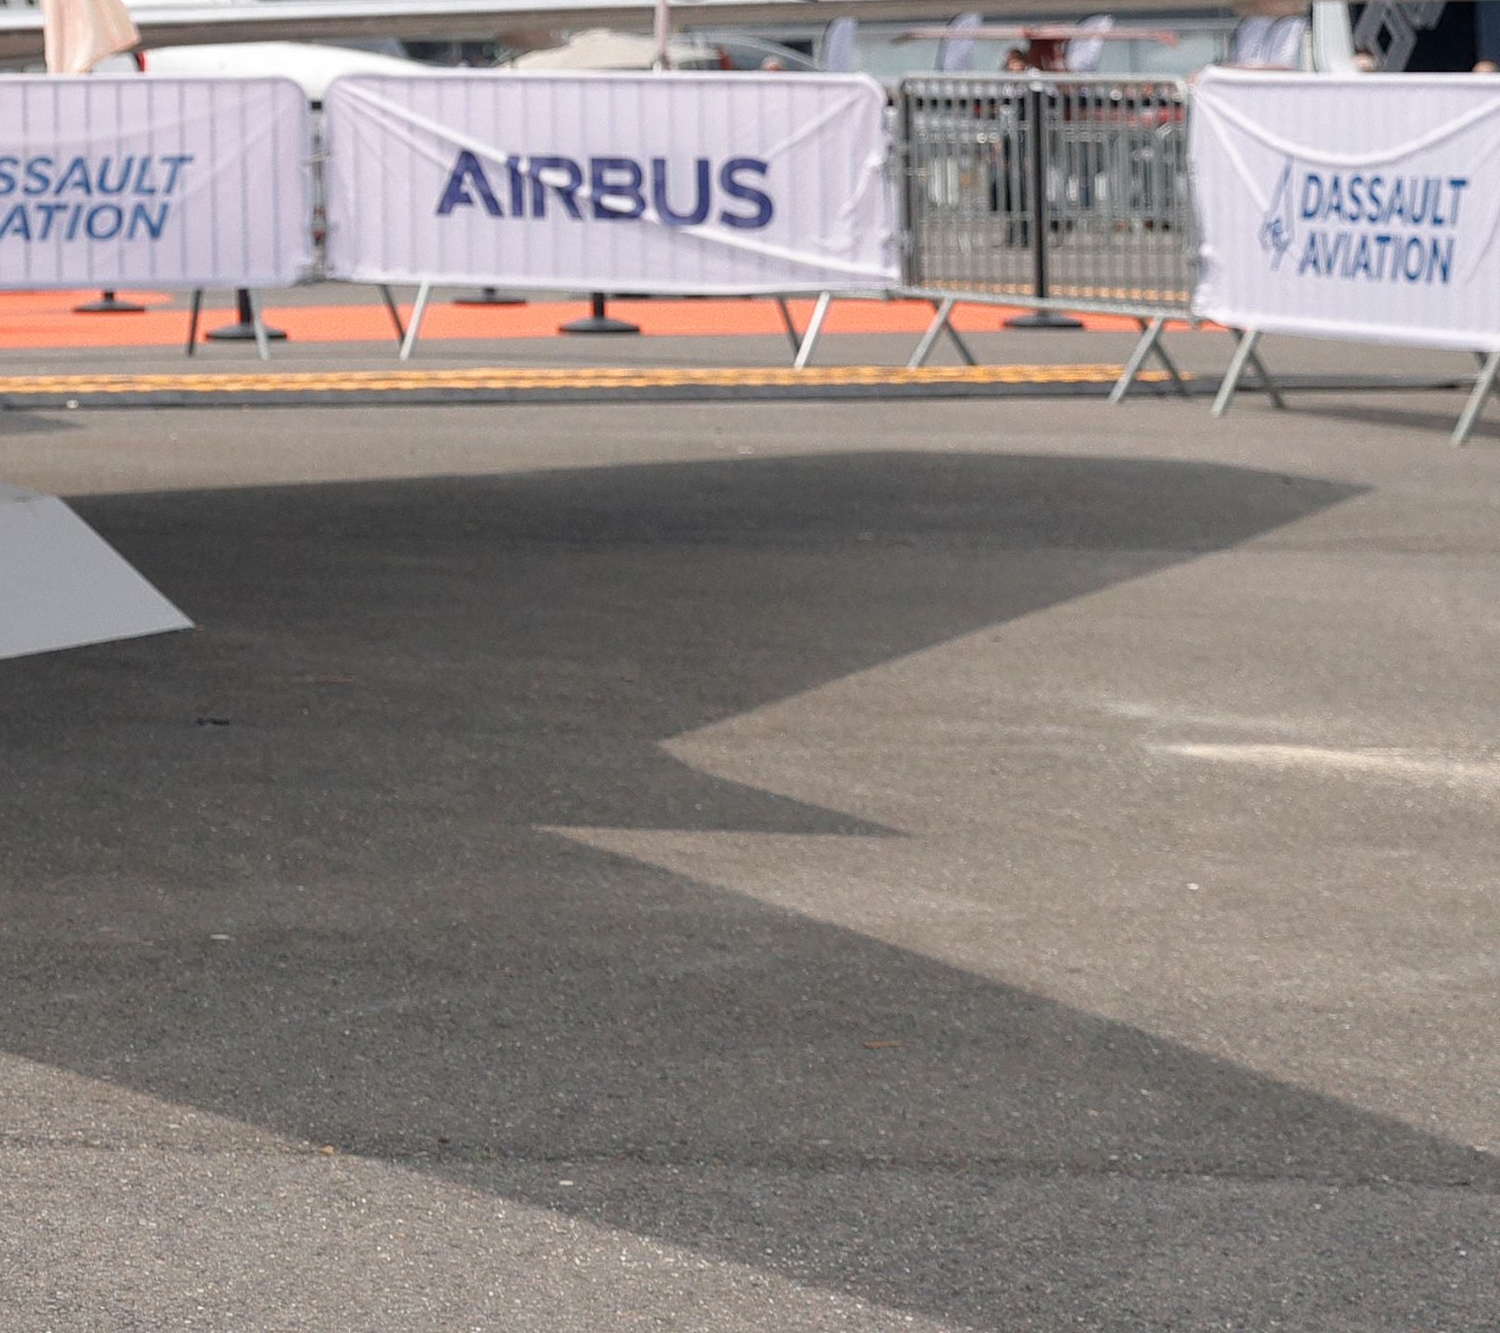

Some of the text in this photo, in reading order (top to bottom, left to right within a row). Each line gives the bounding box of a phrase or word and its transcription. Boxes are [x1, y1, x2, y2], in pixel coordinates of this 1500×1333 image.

[436, 150, 773, 229] AIRBUS
[1301, 174, 1468, 225] DASSAULT
[1297, 230, 1454, 282] AVIATION
